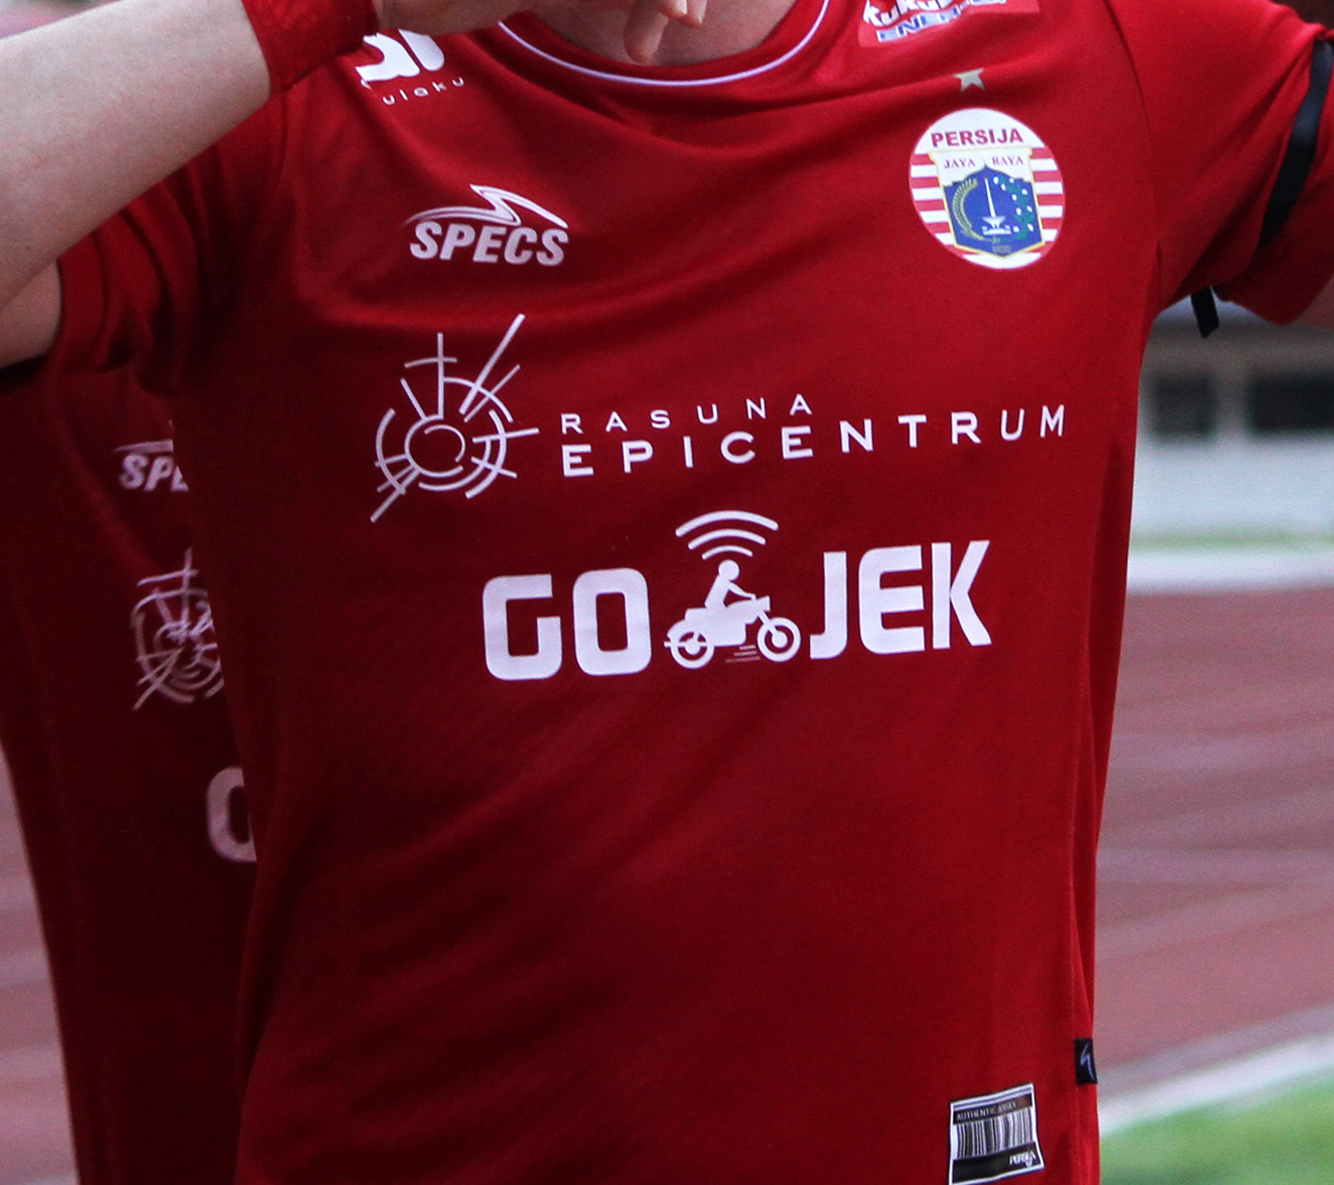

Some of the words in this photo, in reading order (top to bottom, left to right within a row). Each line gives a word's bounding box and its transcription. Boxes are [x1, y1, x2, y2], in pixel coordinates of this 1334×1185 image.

[930, 127, 1025, 148] PERSIJA
[943, 158, 976, 170] JAYA
[991, 155, 1025, 166] RAYA
[408, 219, 569, 267] SPECS
[561, 393, 813, 434] RASUNA
[563, 403, 1065, 478] EPICENTRUM
[809, 539, 992, 660] JEK
